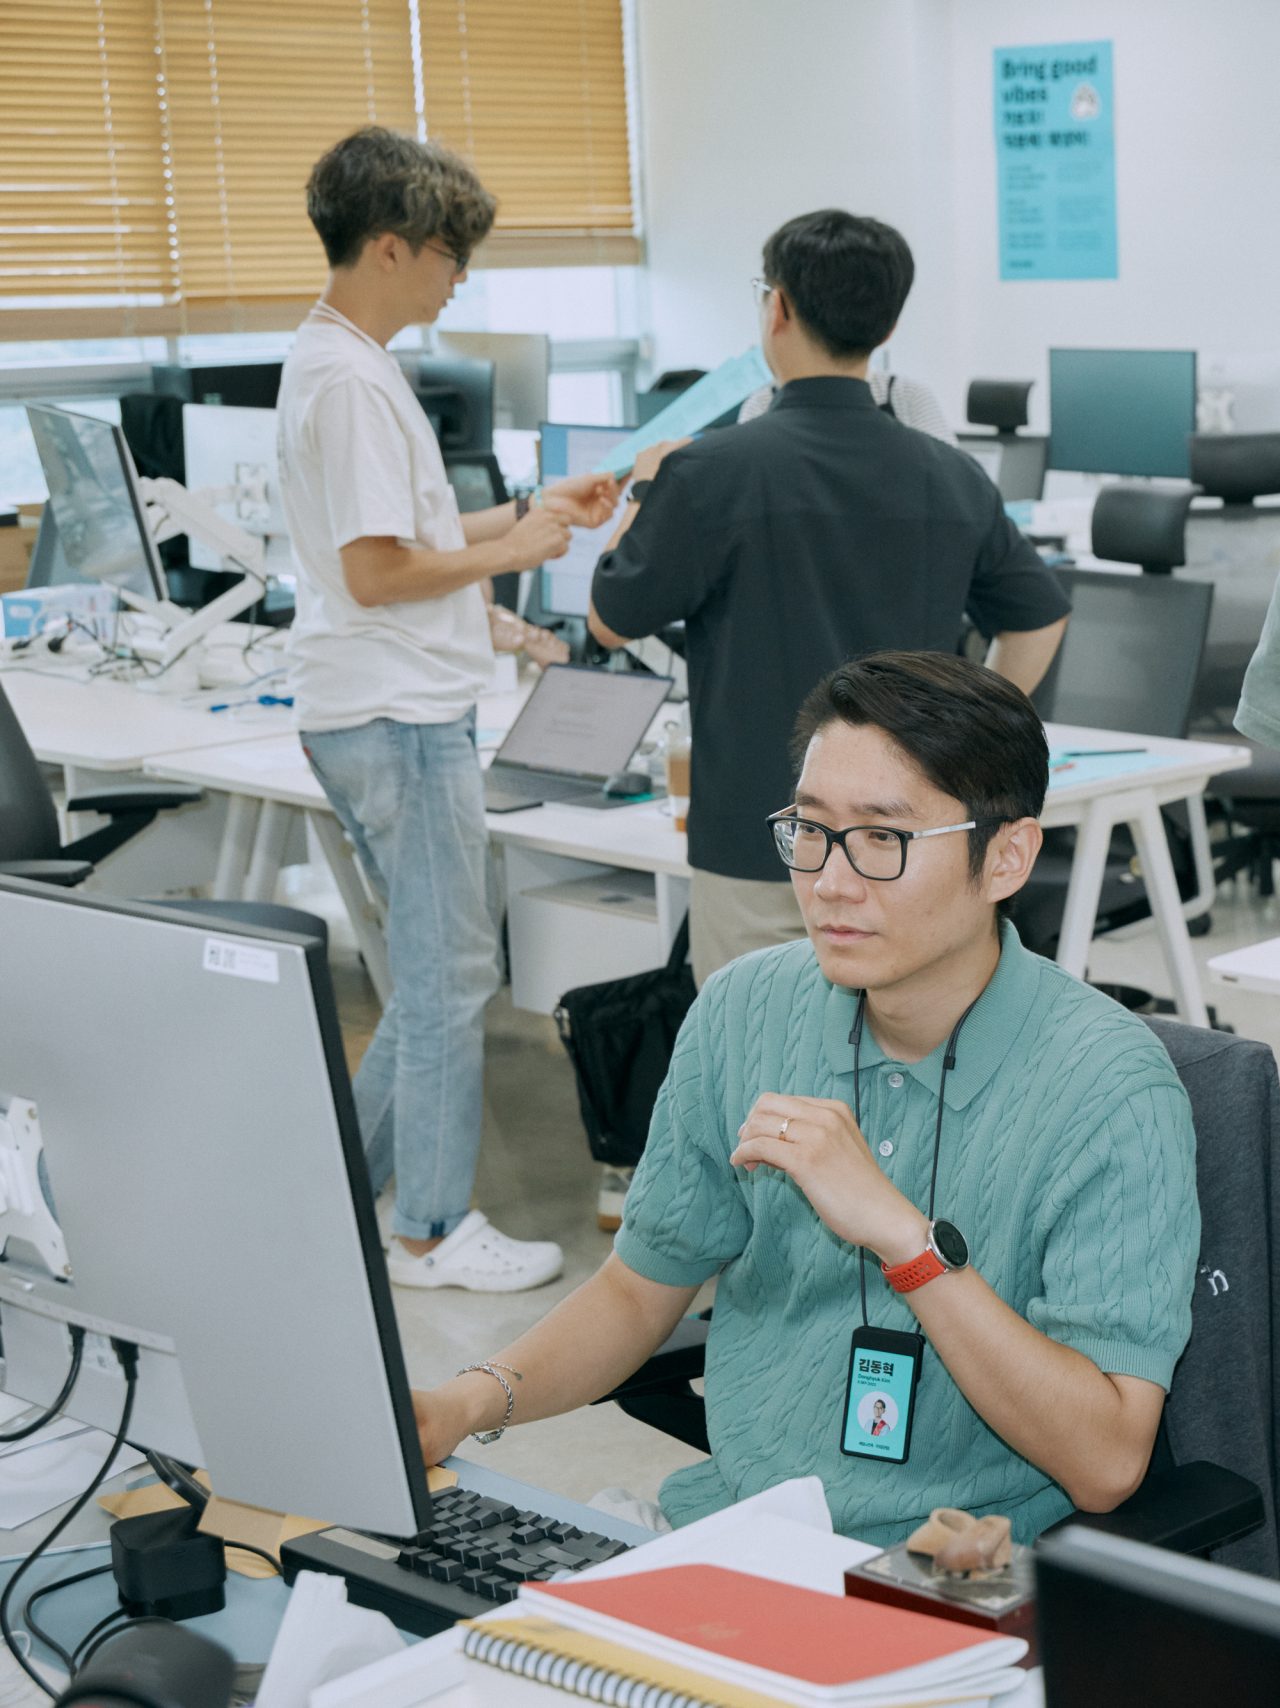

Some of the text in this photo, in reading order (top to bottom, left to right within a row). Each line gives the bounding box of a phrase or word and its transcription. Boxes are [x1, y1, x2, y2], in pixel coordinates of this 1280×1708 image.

[1002, 55, 1097, 81] Bring good
[1002, 85, 1047, 102] vibes
[859, 1359, 894, 1377] 김동혁
